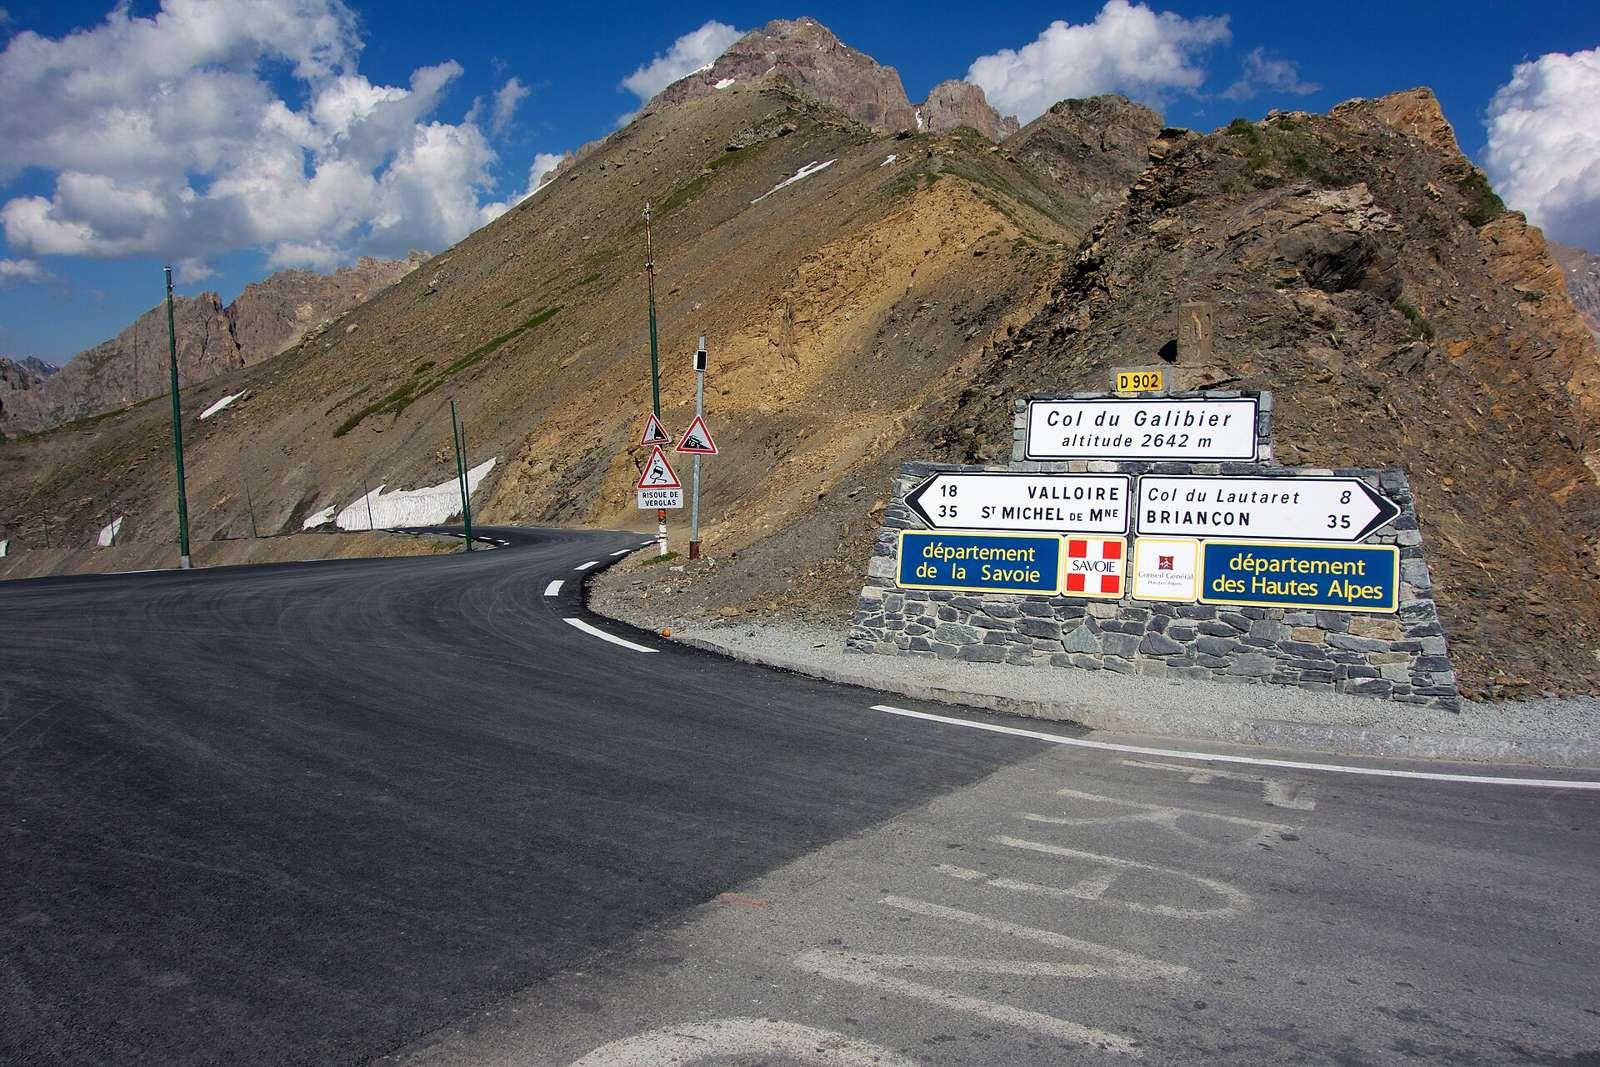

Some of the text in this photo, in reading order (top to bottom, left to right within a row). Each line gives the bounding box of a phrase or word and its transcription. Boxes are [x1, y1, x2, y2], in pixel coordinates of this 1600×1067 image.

[1120, 374, 1160, 389] D 902
[1046, 410, 1232, 428] Col du Galibier
[1061, 433, 1213, 448] altitude 2642 m
[939, 484, 1119, 501] 18 VALLOIRE
[1147, 487, 1353, 505] Col du Lautaret 8
[645, 499, 677, 507] VERGLAS
[938, 505, 958, 519] 35
[1001, 506, 1065, 522] MICHEL
[1146, 510, 1352, 529] BRIANÇON 35
[922, 542, 1036, 563] département
[916, 562, 1041, 583] de la Savoie
[1072, 559, 1116, 573] SAVOIE
[1229, 553, 1366, 576] département
[1212, 574, 1384, 603] des Hautes Alpes
